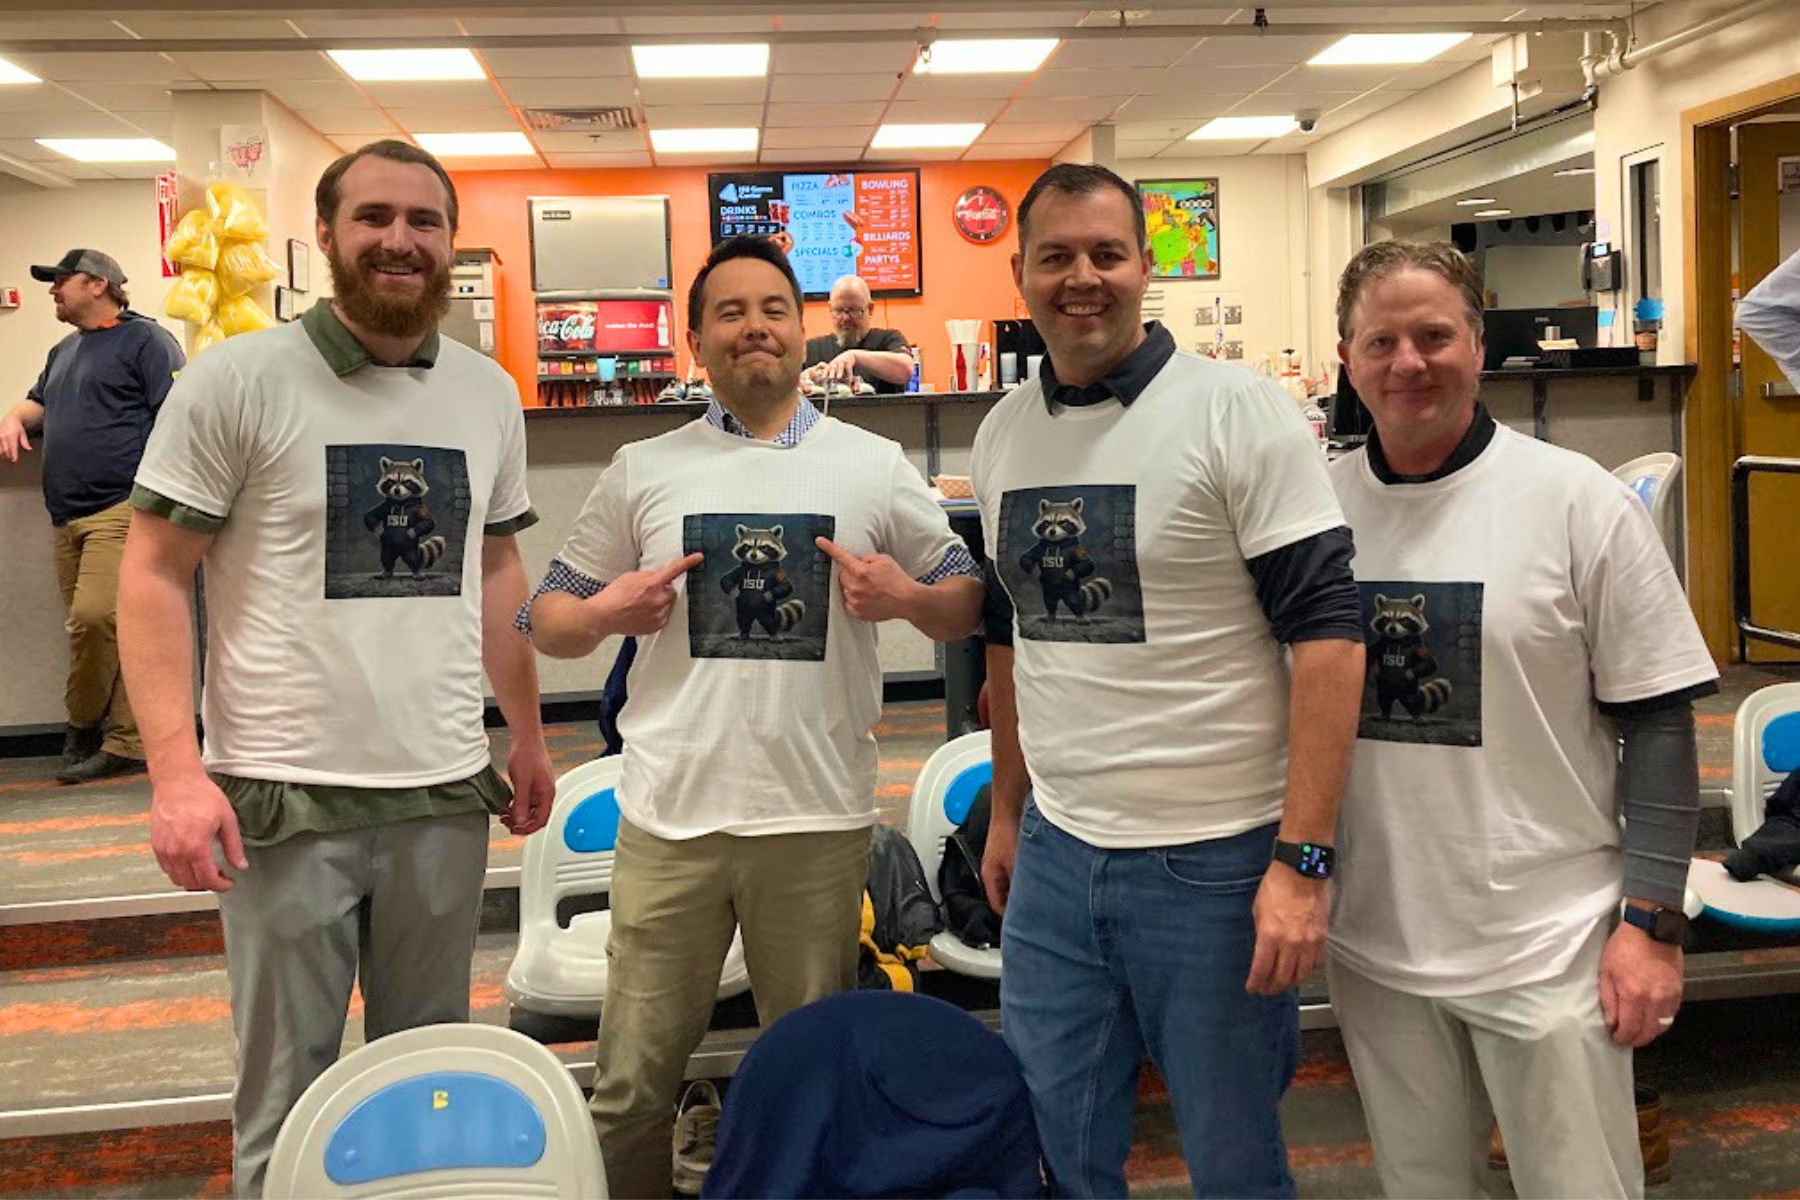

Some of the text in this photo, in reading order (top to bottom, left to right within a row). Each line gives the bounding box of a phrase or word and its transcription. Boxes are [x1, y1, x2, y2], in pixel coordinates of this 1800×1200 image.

[791, 181, 819, 191] PIZZA
[861, 179, 909, 190] BOWLING
[720, 205, 757, 216] DRINKS
[793, 209, 836, 220] COMBOS
[863, 231, 911, 242] BILLIARDS
[795, 246, 839, 257] SPECIALS
[864, 254, 900, 265] PARTYS
[386, 514, 409, 527] ISU
[1042, 556, 1065, 568] ISU
[743, 578, 767, 590] ISU
[1382, 653, 1406, 668] ISU
